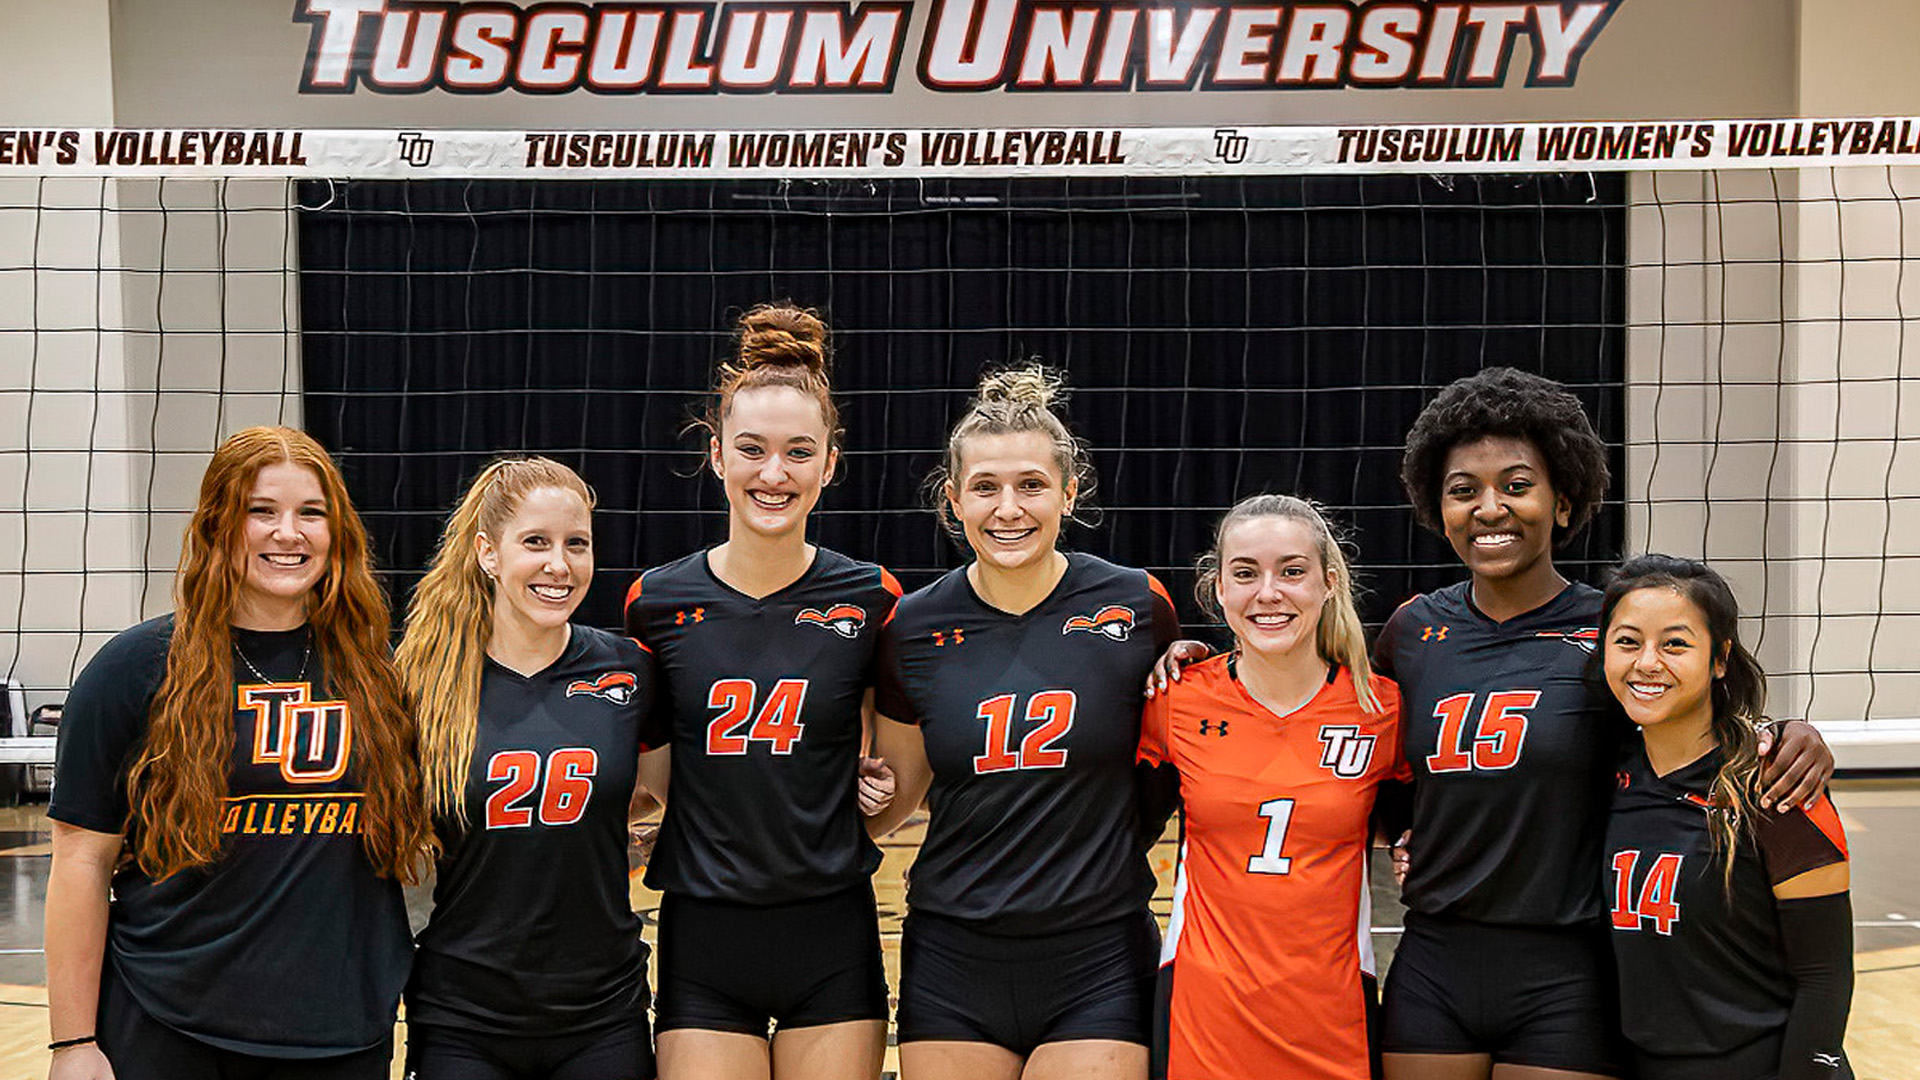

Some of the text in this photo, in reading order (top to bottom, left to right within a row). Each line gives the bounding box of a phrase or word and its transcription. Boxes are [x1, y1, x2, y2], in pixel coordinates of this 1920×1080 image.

[294, 0, 1617, 94] TUSCULUM UNIVERSITY
[95, 131, 307, 166] VOLLEYBALL
[398, 132, 433, 167] TU
[525, 131, 1126, 168] TUSCULUM WOMEN'S VOLLEYBALL
[1214, 129, 1248, 165] TU
[1337, 120, 1920, 164] TUSCULUM WOMEN'S VOLLEYBAL
[238, 682, 352, 784] TU
[706, 679, 809, 755] 24
[973, 690, 1077, 775] 12
[1319, 725, 1377, 779] TU
[1426, 690, 1542, 775] 15
[222, 802, 365, 834] OLLEYBA
[486, 748, 598, 830] 26
[1247, 798, 1296, 875] 1
[1611, 850, 1686, 936] 14
